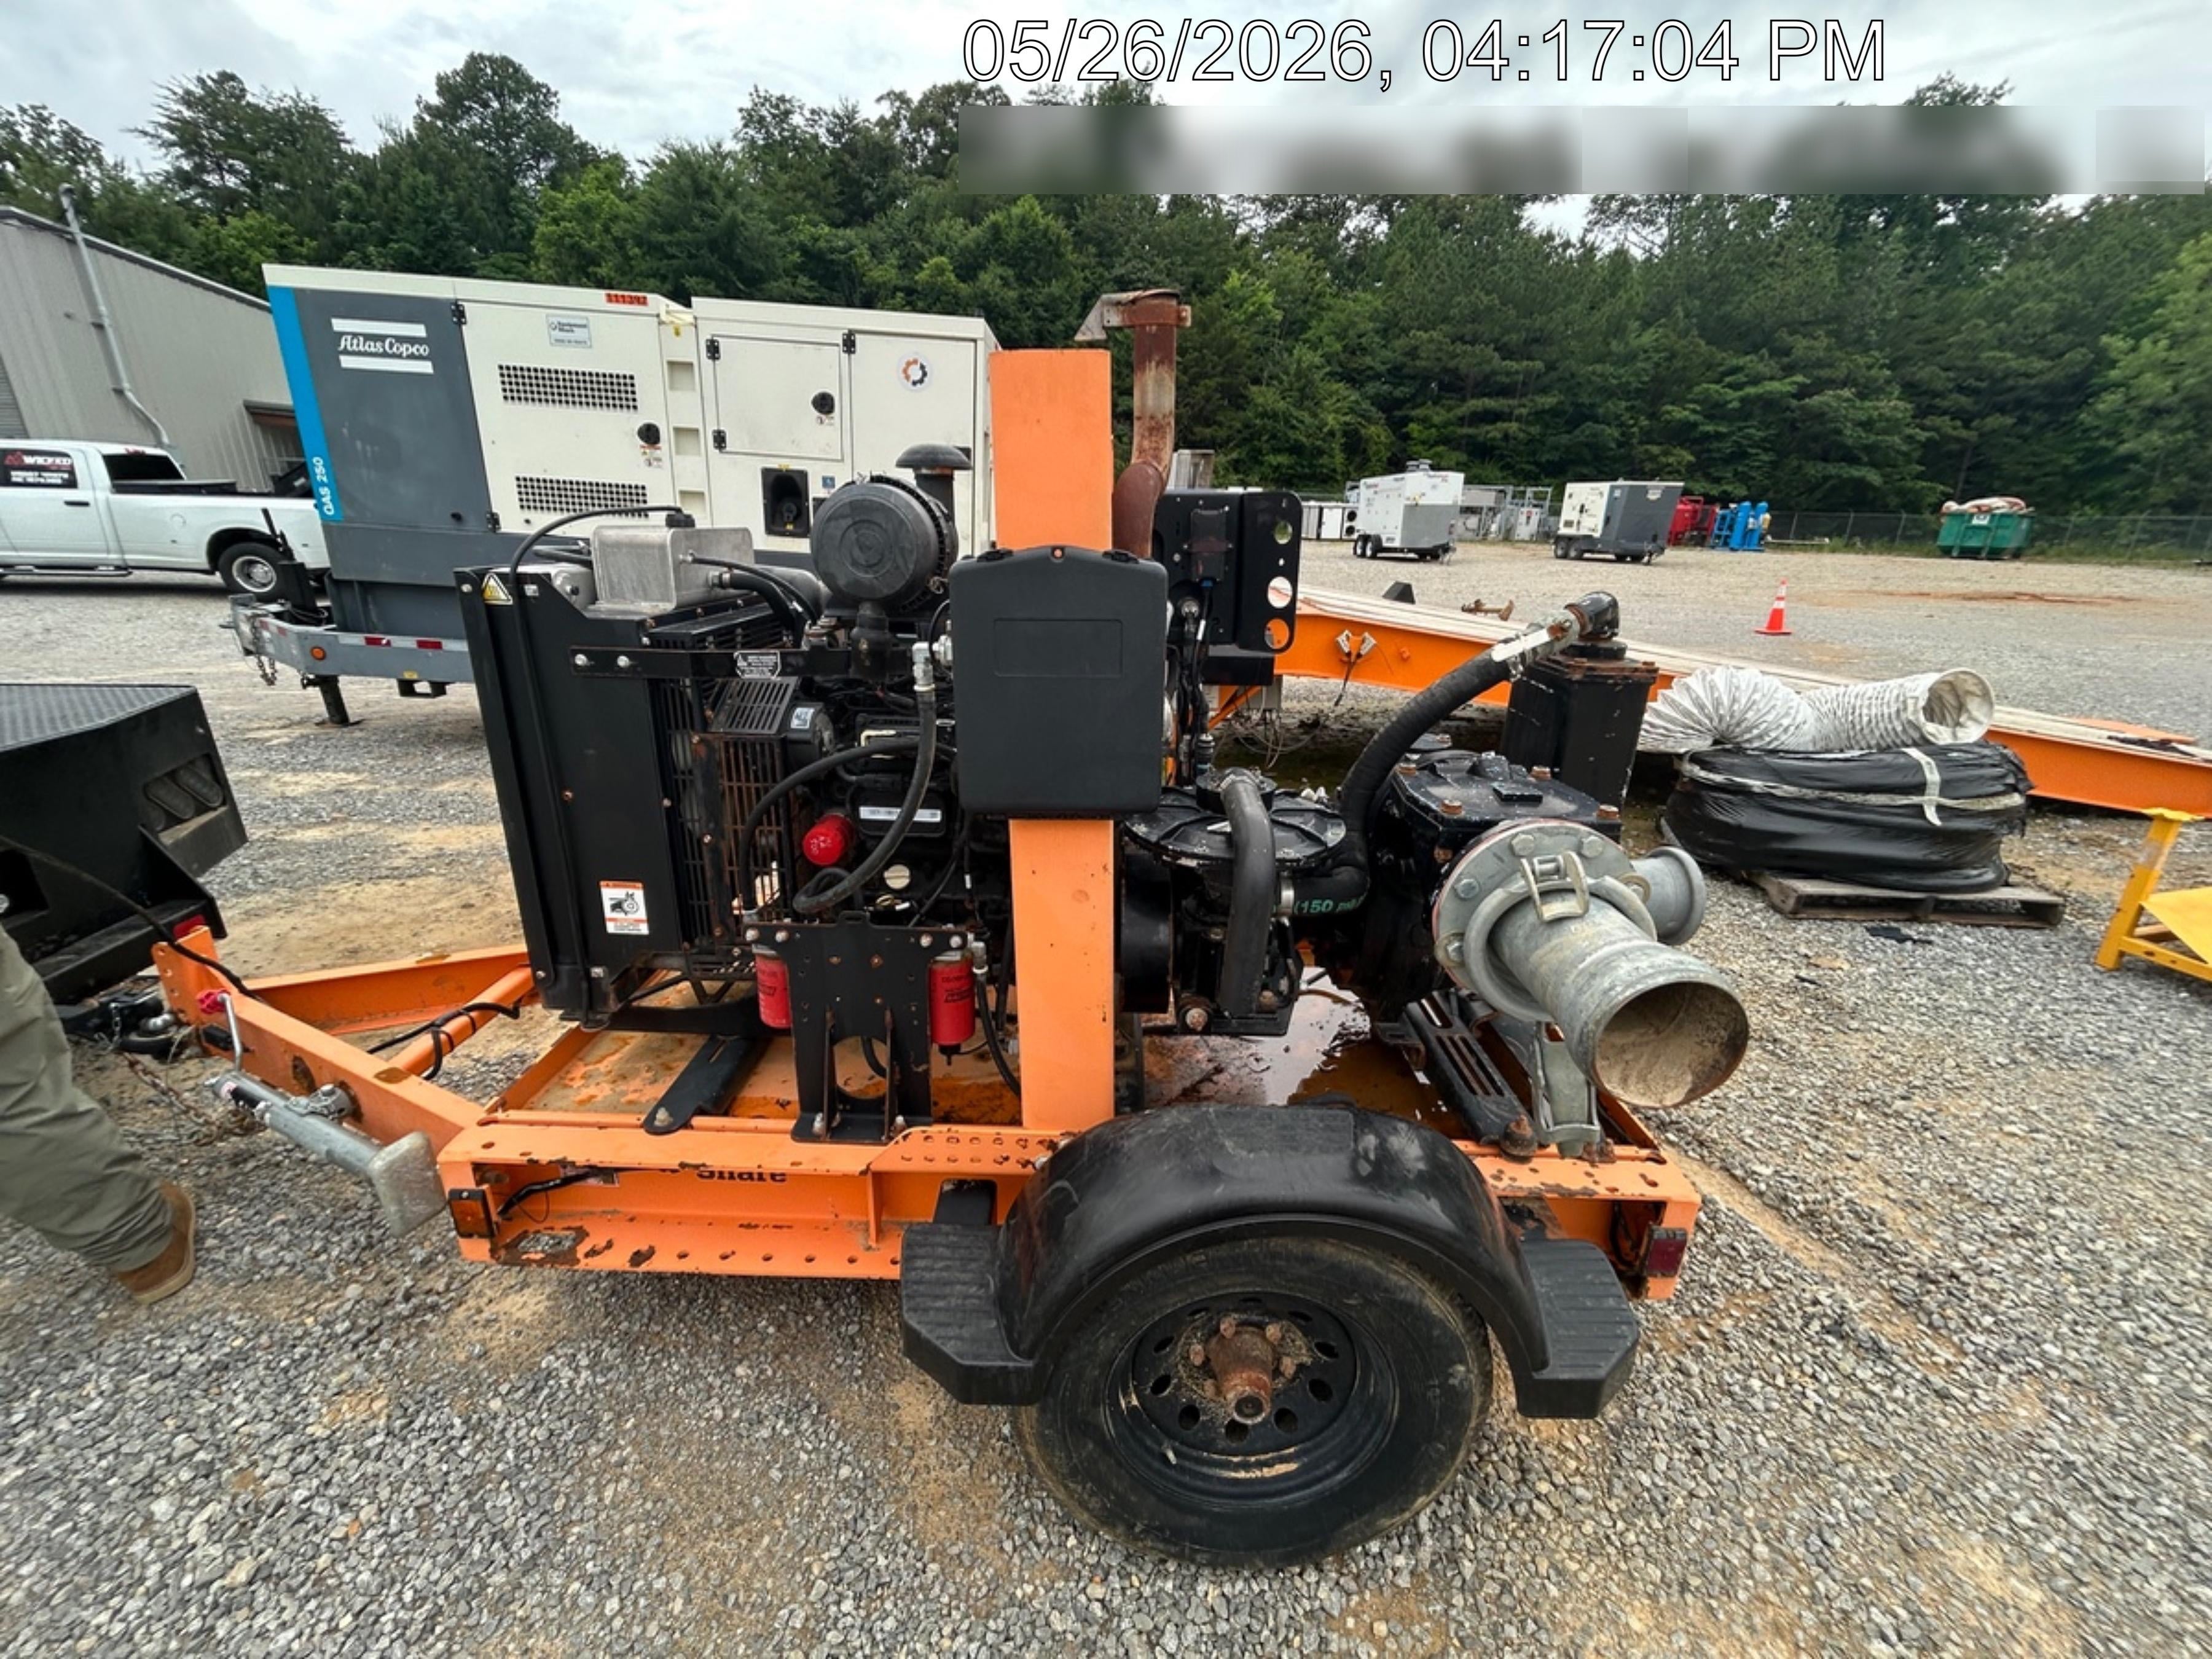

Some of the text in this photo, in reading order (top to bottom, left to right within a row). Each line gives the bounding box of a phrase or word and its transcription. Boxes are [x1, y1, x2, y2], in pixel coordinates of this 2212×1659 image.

[338, 335, 429, 358] Atlas Copco
[312, 457, 329, 484] 250
